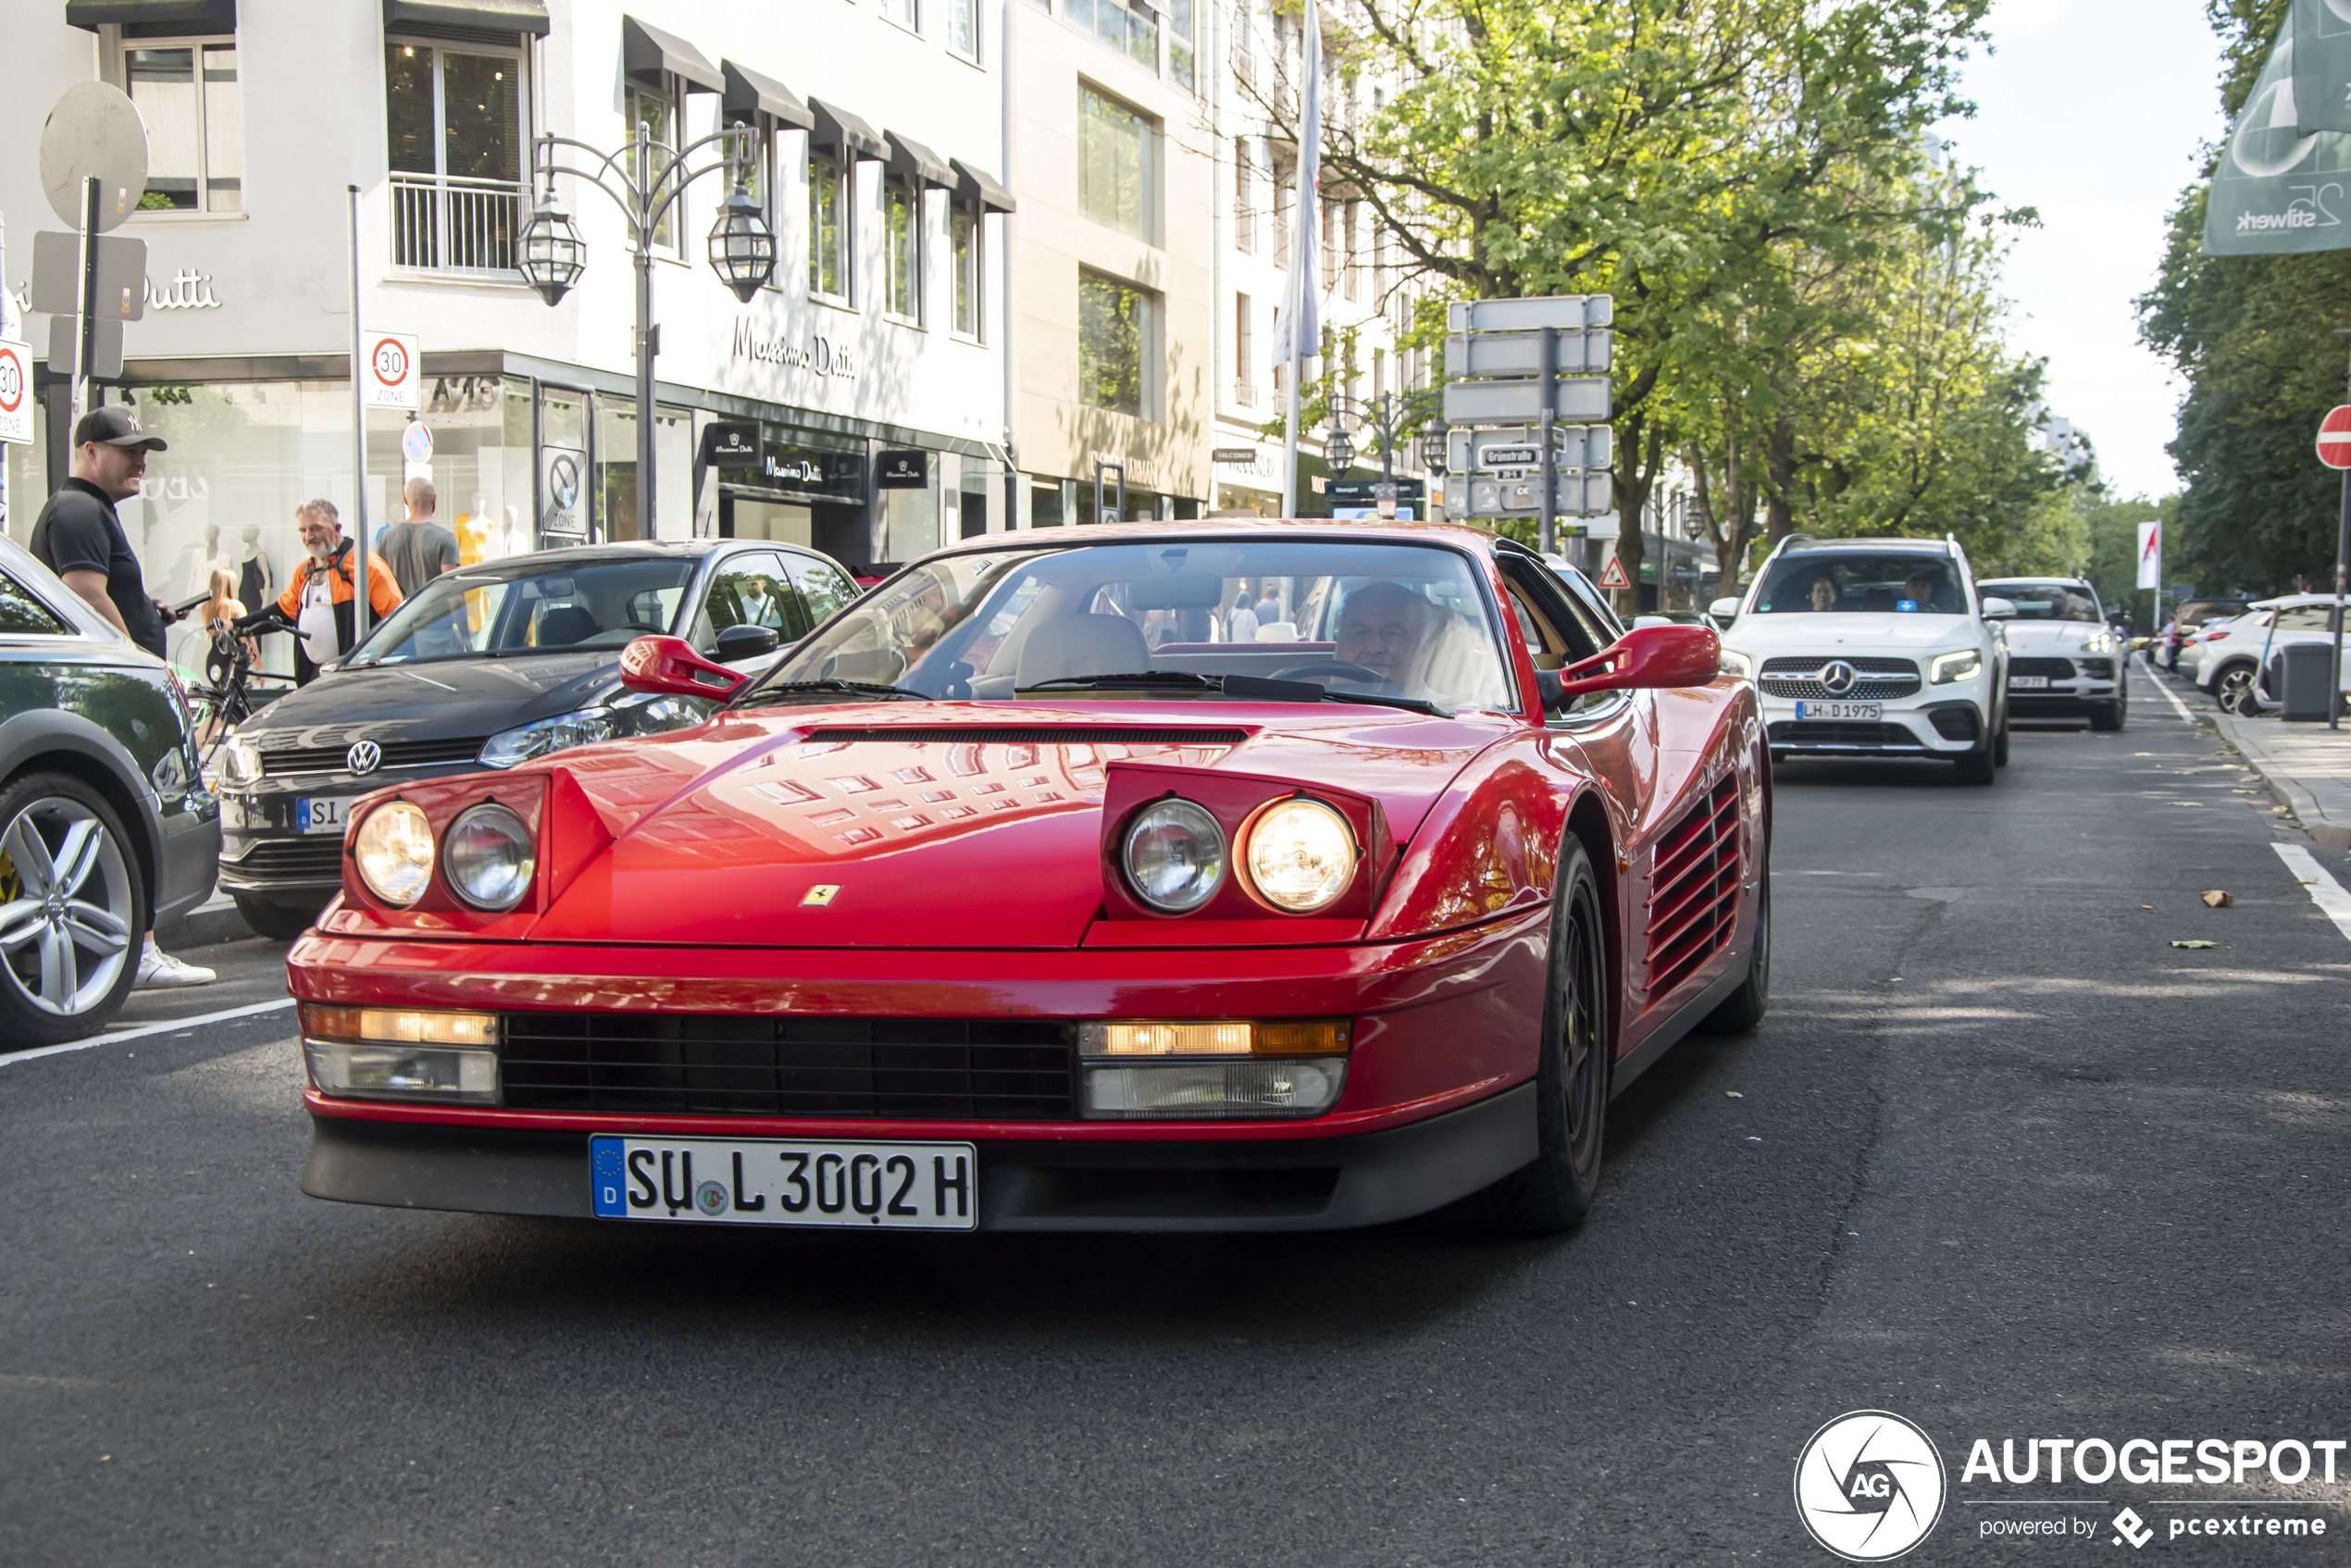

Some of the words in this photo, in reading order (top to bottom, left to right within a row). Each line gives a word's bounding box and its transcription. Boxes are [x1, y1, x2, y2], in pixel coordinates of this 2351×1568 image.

[144, 268, 222, 310] utti
[733, 315, 811, 368] Massimo
[814, 334, 855, 380] Dutti
[379, 351, 402, 373] 30
[0, 365, 18, 395] 30
[377, 389, 405, 403] ZONE
[1217, 452, 1254, 460] FALCONERI
[1488, 451, 1532, 463] Grünstraße
[765, 455, 802, 479] Massimo
[802, 460, 823, 482] Dutti
[553, 513, 577, 529] ZONE
[1804, 705, 1822, 717] LH
[1832, 705, 1840, 717] D
[1843, 705, 1878, 718] 1975
[312, 802, 339, 825] SI
[628, 1150, 692, 1211] SU
[732, 1151, 765, 1212] L
[779, 1152, 918, 1216] 3002
[934, 1155, 968, 1216] H
[603, 1187, 616, 1204] D
